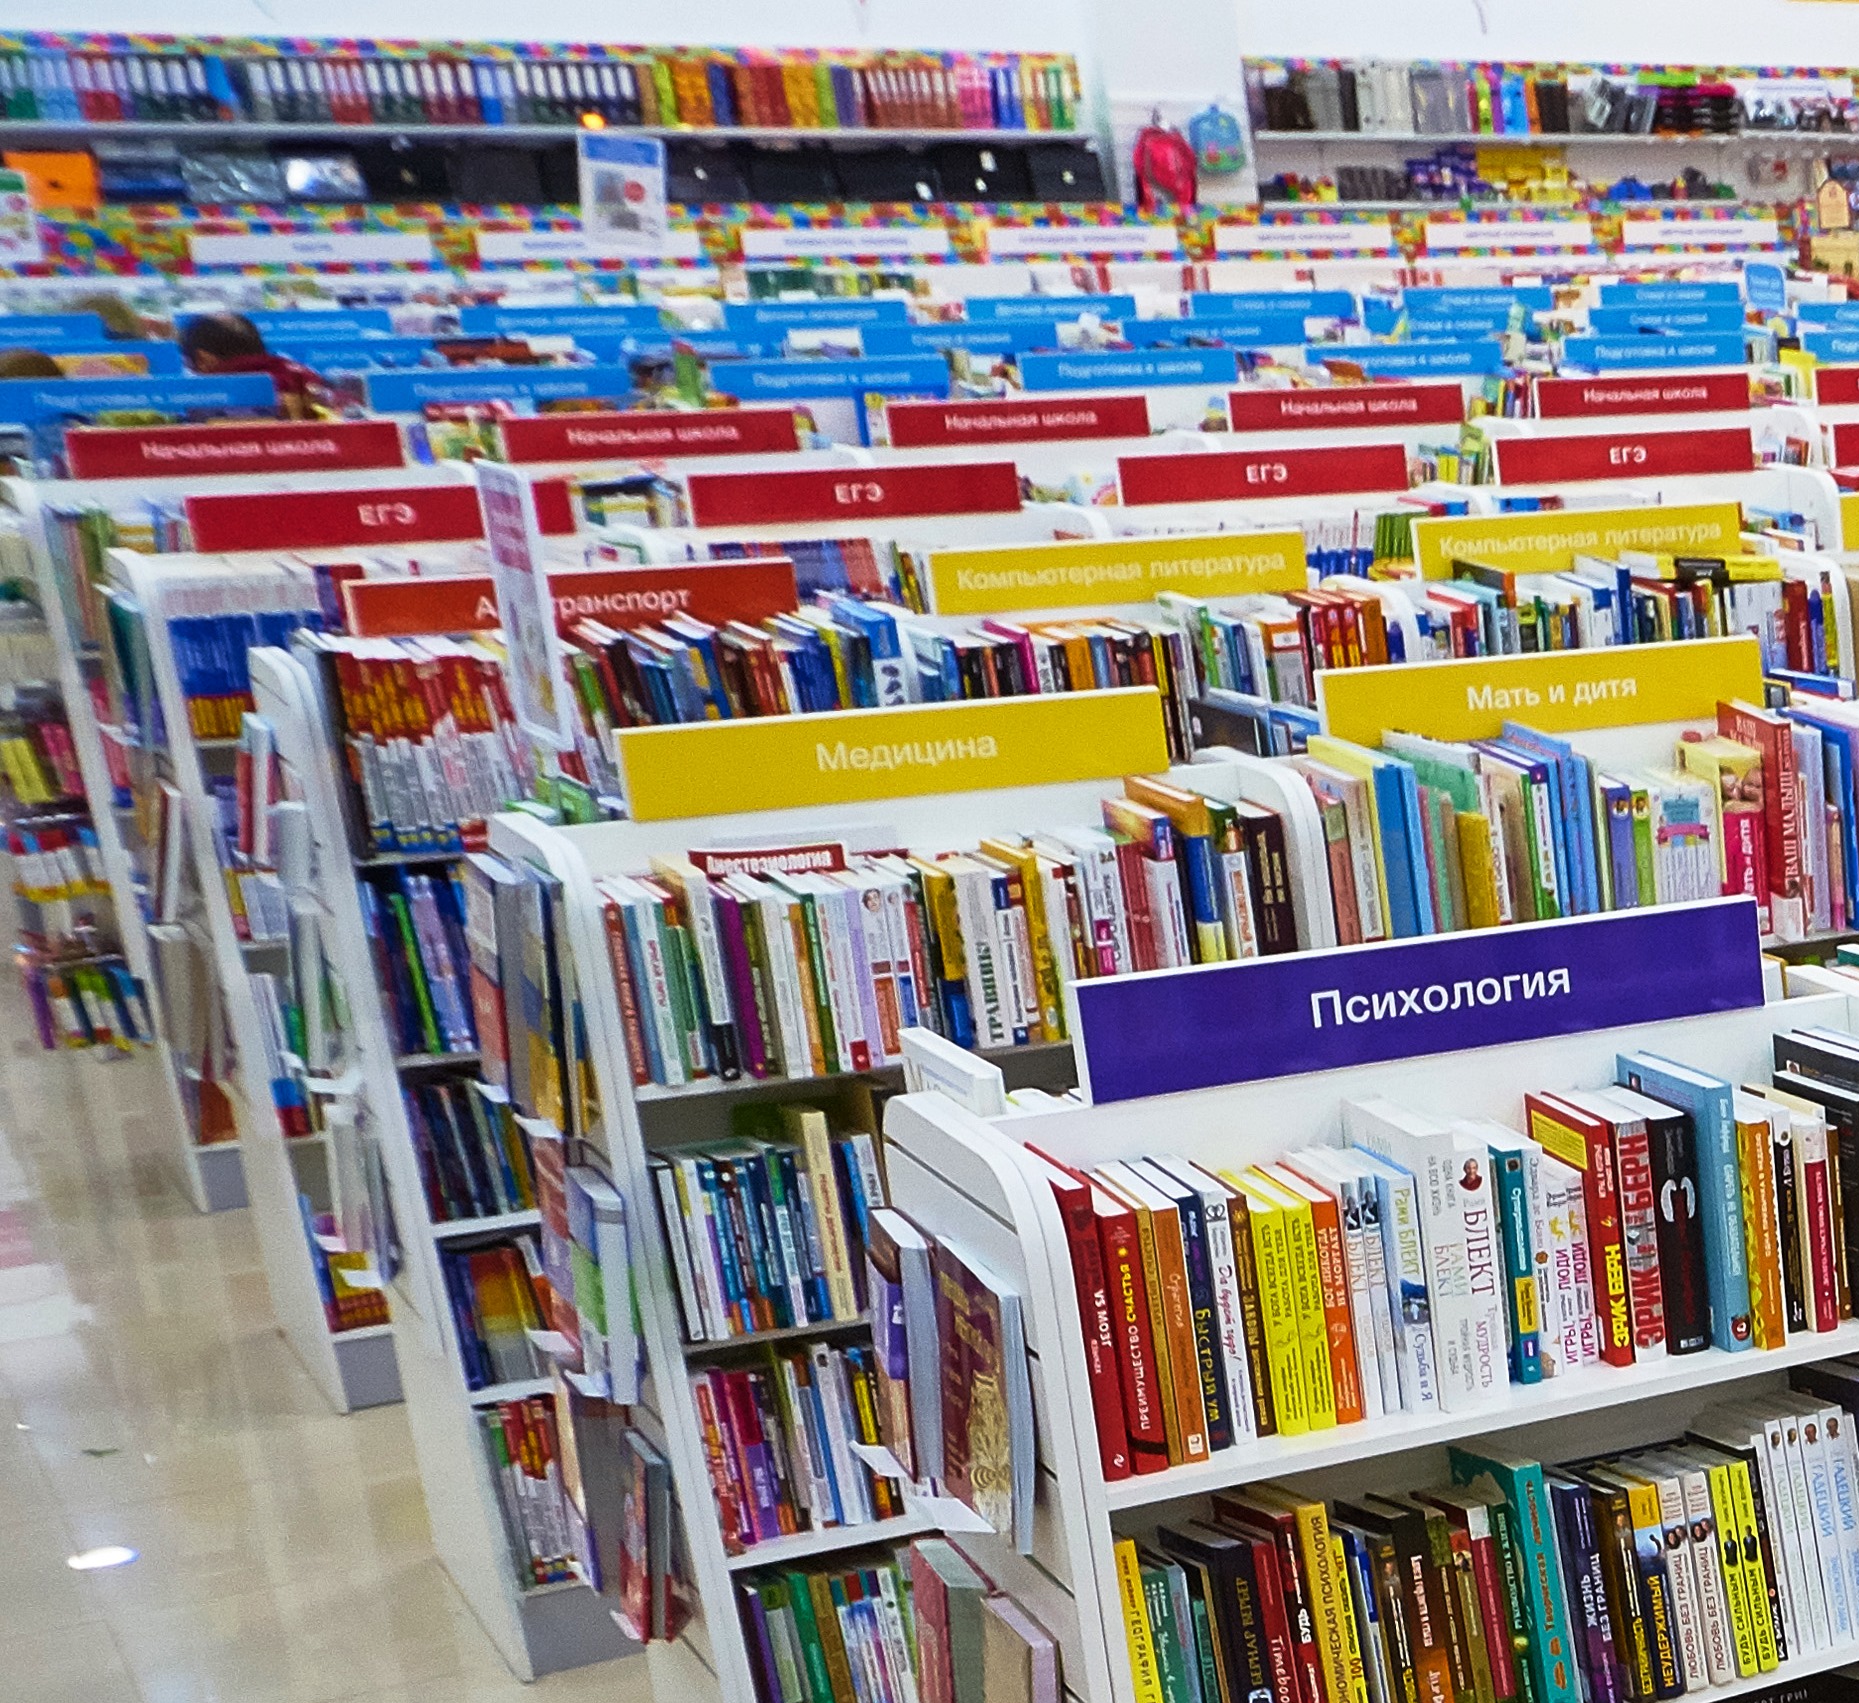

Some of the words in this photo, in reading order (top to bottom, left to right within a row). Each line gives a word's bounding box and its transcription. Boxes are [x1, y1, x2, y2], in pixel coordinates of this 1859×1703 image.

[1281, 401, 1365, 415] Начальная
[1368, 400, 1417, 412] школа
[1584, 389, 1659, 402] Начальная
[1663, 388, 1707, 399] школа
[945, 415, 1038, 430] Начальная
[1042, 412, 1097, 426] школа
[1247, 464, 1287, 483] ЕГЭ
[1610, 446, 1646, 464] ЕГЭ
[835, 483, 883, 503] ЕГЭ
[358, 503, 416, 525] ЕГЭ
[1440, 529, 1598, 557] Компьютерная
[1604, 520, 1720, 548] литература
[958, 564, 1141, 589] Компьютерная
[1151, 555, 1284, 577] литература
[1467, 685, 1540, 710] Мать
[1549, 685, 1565, 703] и
[1574, 678, 1636, 706] дитя
[816, 736, 997, 771] Медицина
[1311, 968, 1570, 1028] Психология
[1463, 1207, 1496, 1297] БЛЕКТ
[1604, 1243, 1623, 1285] БЕРН
[1122, 1263, 1138, 1322] СЧАСТЬЯ
[1611, 1289, 1631, 1348] ЭРИК
[1128, 1324, 1149, 1431] ПРЕИМУЩЕСТВО
[1310, 1515, 1335, 1608] ПСИХОЛОГИЯ
[1583, 1573, 1598, 1628] ЖИЗНЬ
[1129, 1606, 1153, 1686] ГЕОГРАФИЯ
[1645, 1574, 1676, 1688] НЕУДЕРЖИМЫЙ
